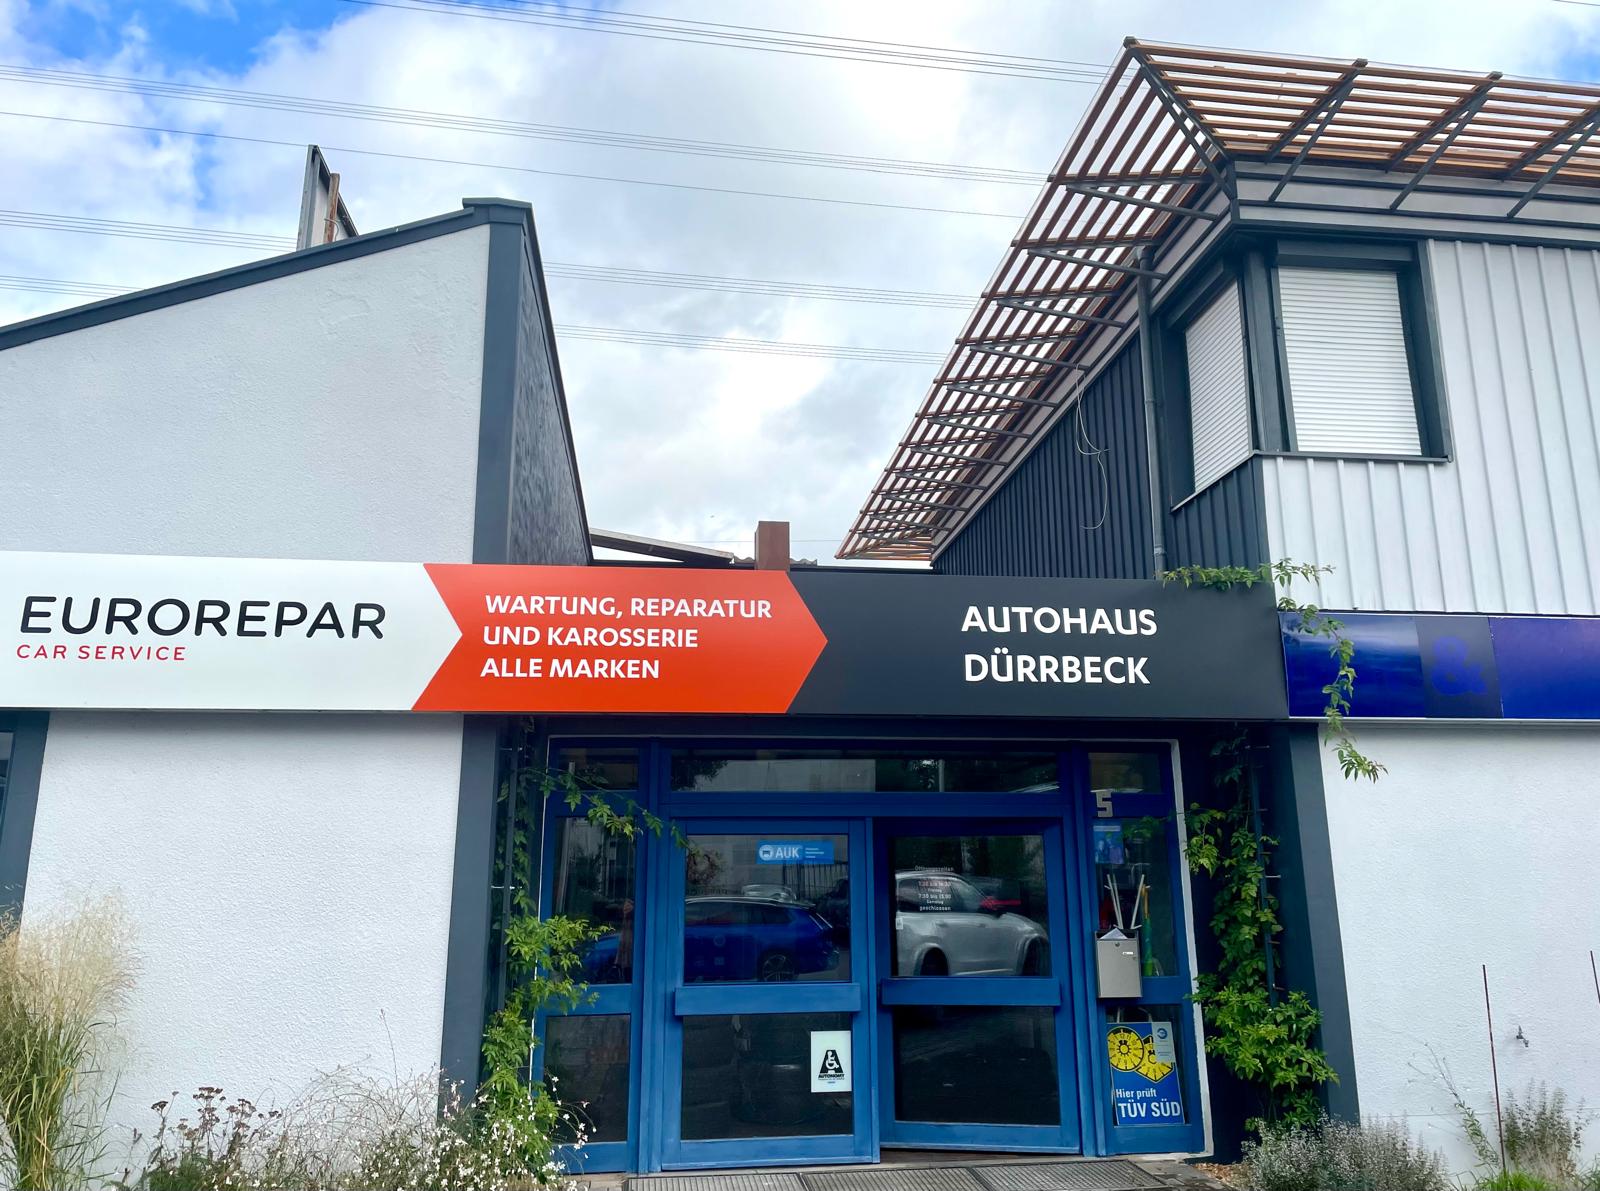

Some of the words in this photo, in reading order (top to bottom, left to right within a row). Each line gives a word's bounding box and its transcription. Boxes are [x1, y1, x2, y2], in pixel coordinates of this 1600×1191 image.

[20, 595, 386, 640] EUROREPAR
[485, 594, 623, 620] WARTUNG,
[630, 598, 773, 619] REPARATUR
[961, 605, 1158, 636] AUTOHAUS
[483, 626, 540, 646] UND
[547, 626, 698, 648] KAROSSERIE
[16, 644, 67, 660] CAR
[78, 645, 187, 661] SERVICE
[480, 657, 543, 678] ALLE
[549, 658, 660, 680] MARKEN
[964, 647, 1151, 685] DÜRRBECK
[1095, 789, 1114, 818] 5
[775, 846, 800, 859] AUK
[1116, 1088, 1135, 1099] Hier
[1136, 1088, 1157, 1100] prüft
[1117, 1099, 1147, 1118] TÜV
[1151, 1098, 1181, 1118] SÜD
